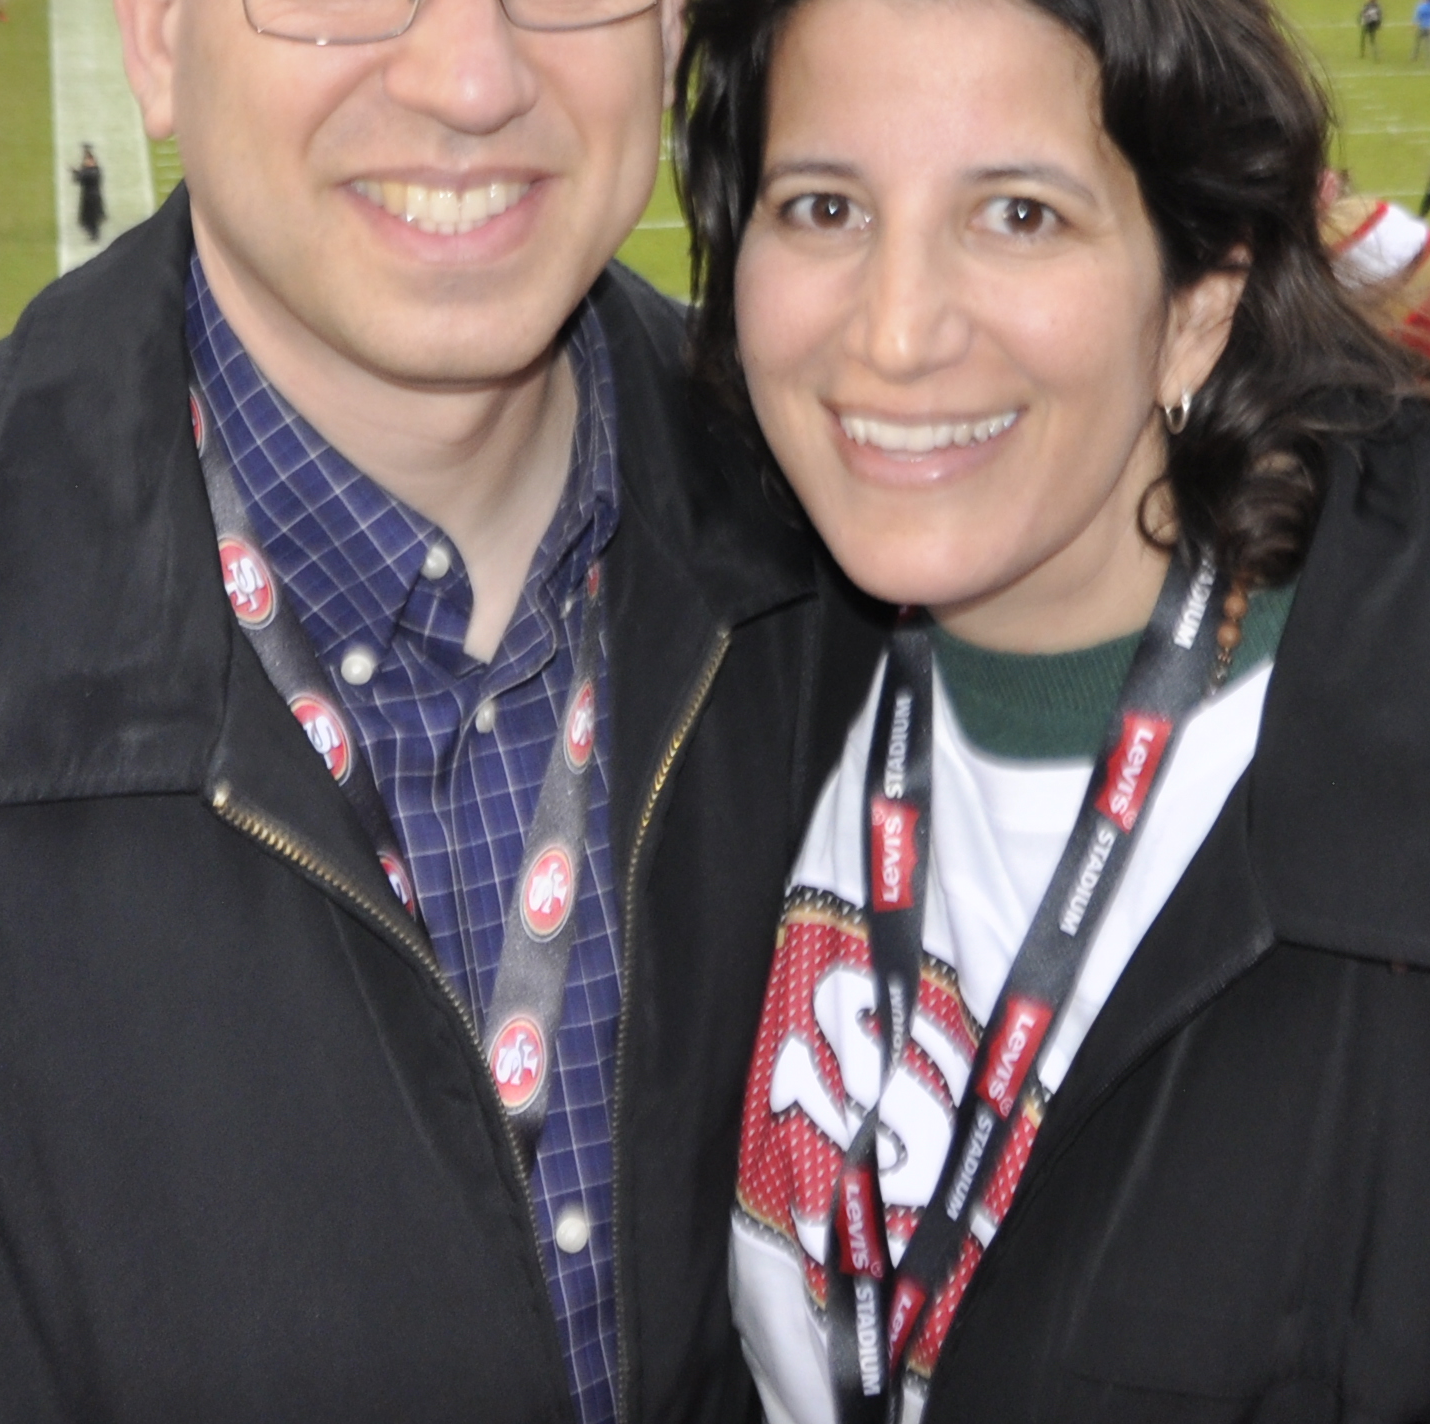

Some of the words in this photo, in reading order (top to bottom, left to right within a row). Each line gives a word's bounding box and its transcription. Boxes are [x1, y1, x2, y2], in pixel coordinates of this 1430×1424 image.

[884, 693, 912, 799] STADIUM
[1059, 828, 1116, 938] STADIUM
[946, 1113, 994, 1222] STADIUM
[855, 1285, 882, 1396] STADIUM
